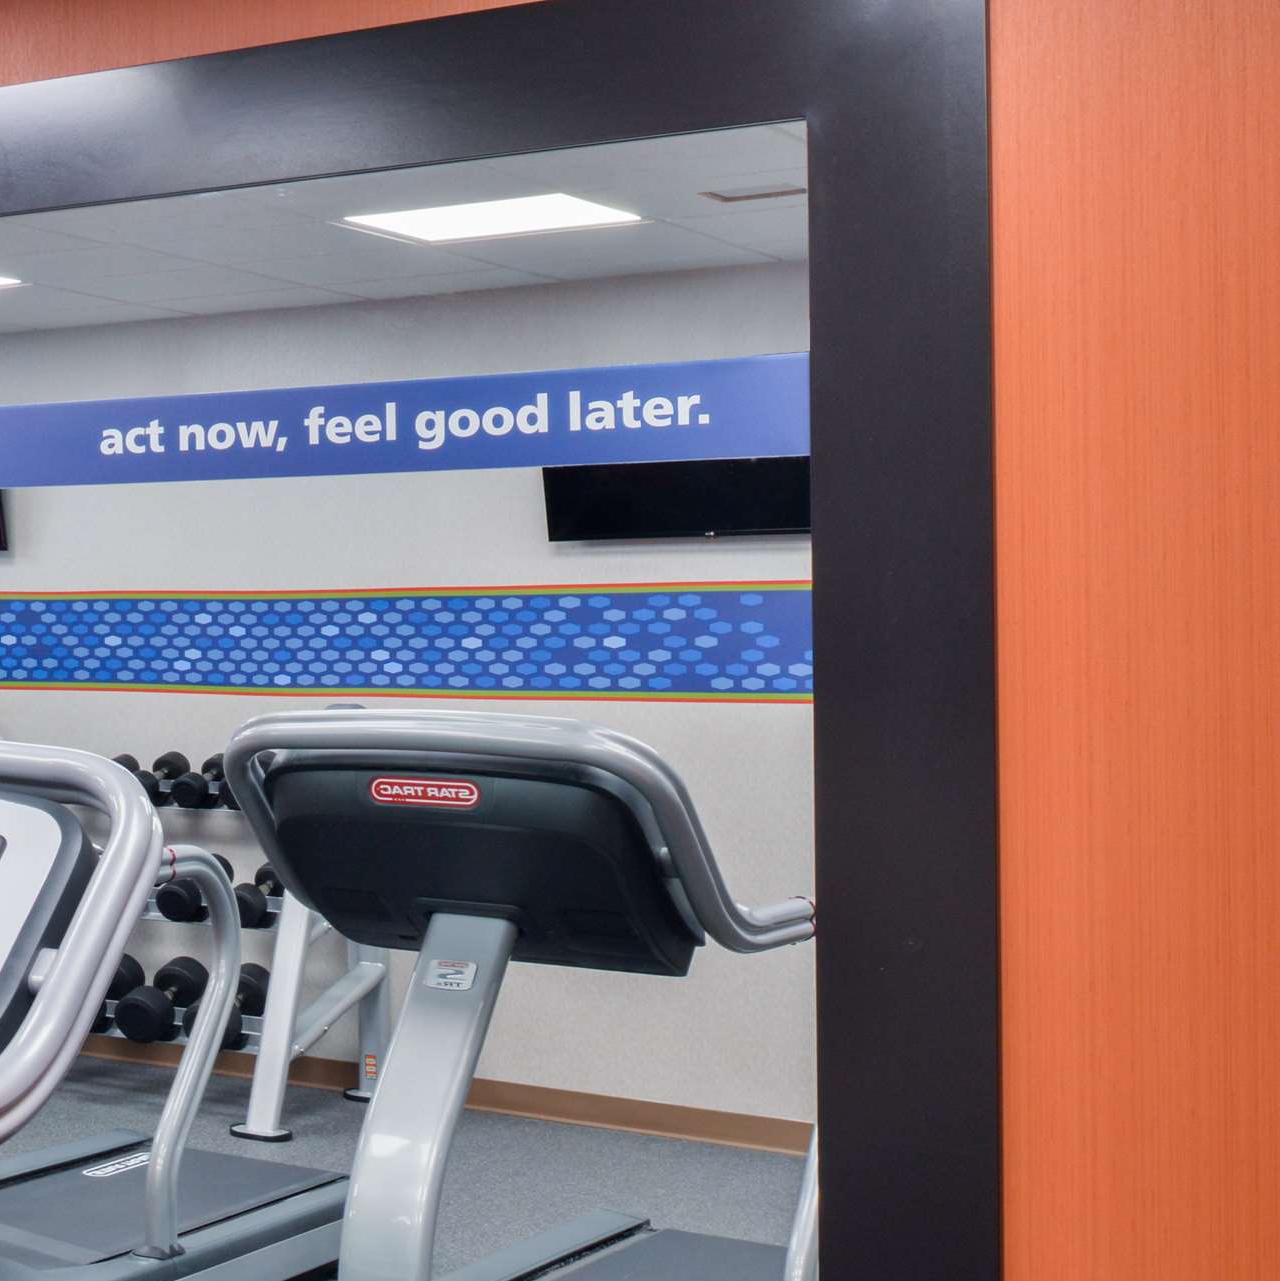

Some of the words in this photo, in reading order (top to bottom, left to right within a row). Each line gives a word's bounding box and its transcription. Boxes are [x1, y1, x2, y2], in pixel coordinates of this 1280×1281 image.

[99, 419, 165, 456] act
[178, 420, 288, 452] now,
[304, 402, 397, 445] feel
[414, 392, 549, 450] good
[568, 390, 710, 432] later.
